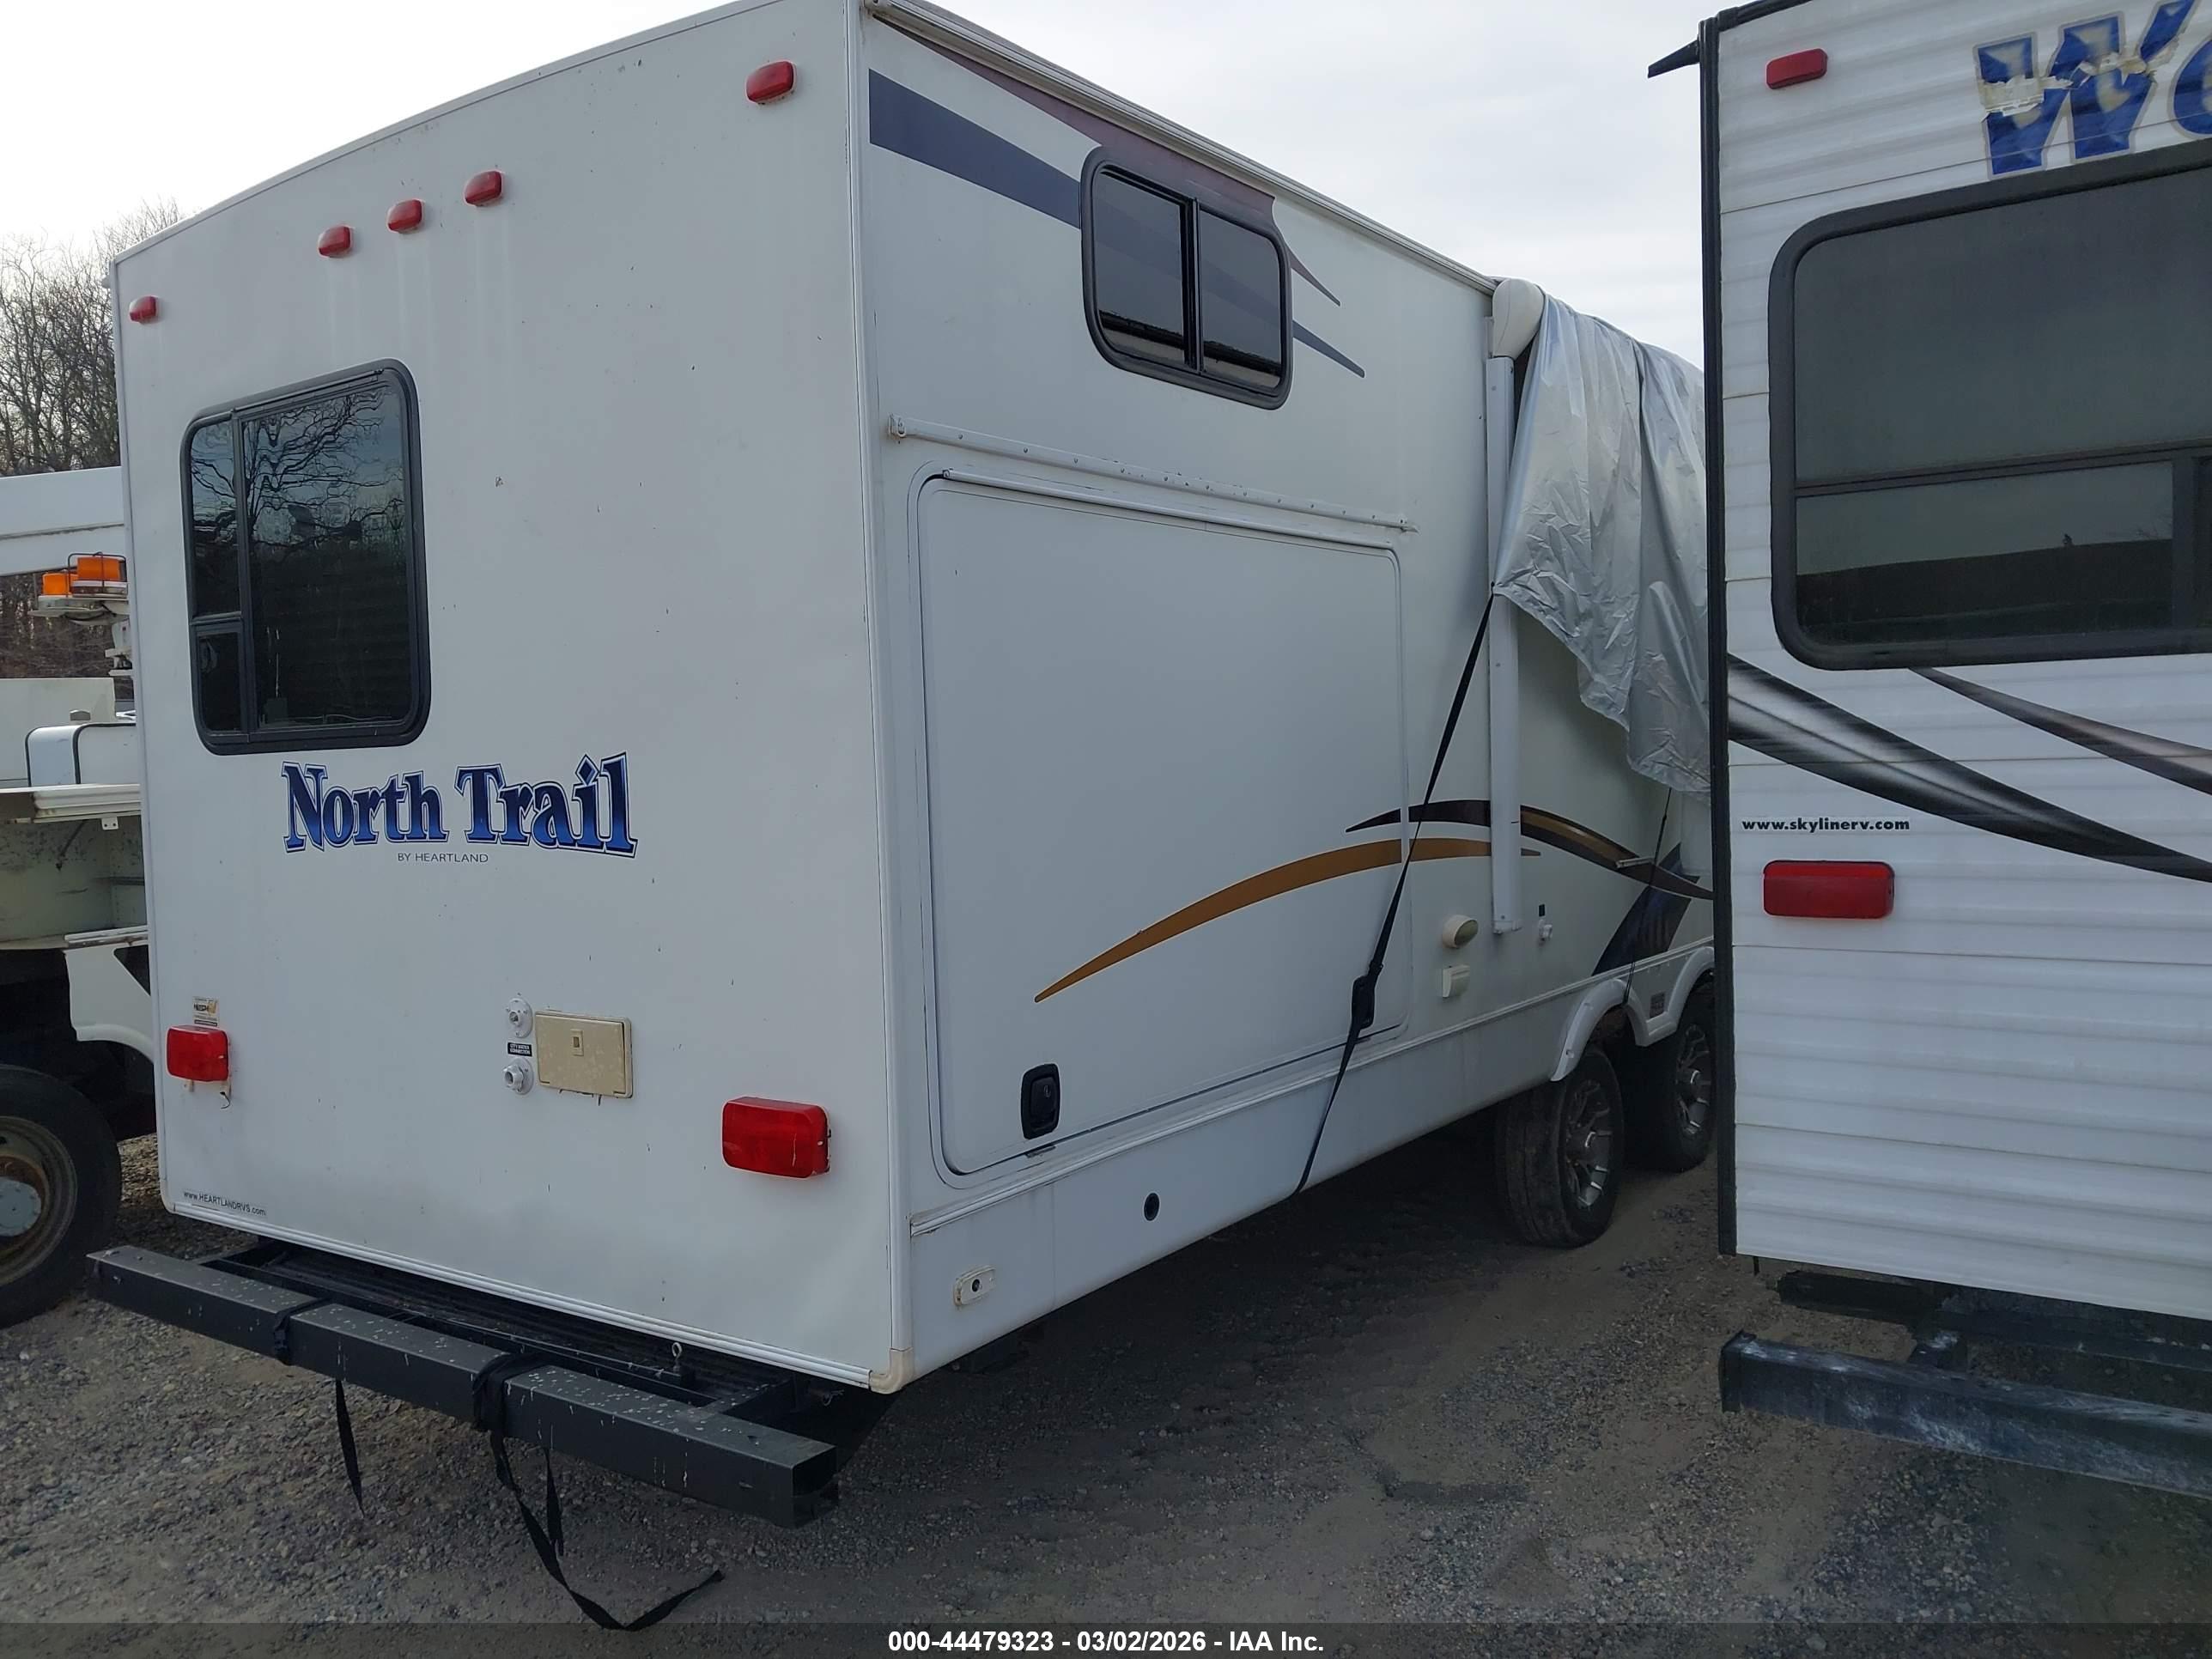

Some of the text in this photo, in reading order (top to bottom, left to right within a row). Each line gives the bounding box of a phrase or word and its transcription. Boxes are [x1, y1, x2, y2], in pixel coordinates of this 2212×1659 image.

[282, 751, 638, 858] North Trail
[1741, 817, 1910, 833] www.skylinerv.com
[398, 853, 489, 863] BY HEARTLAND
